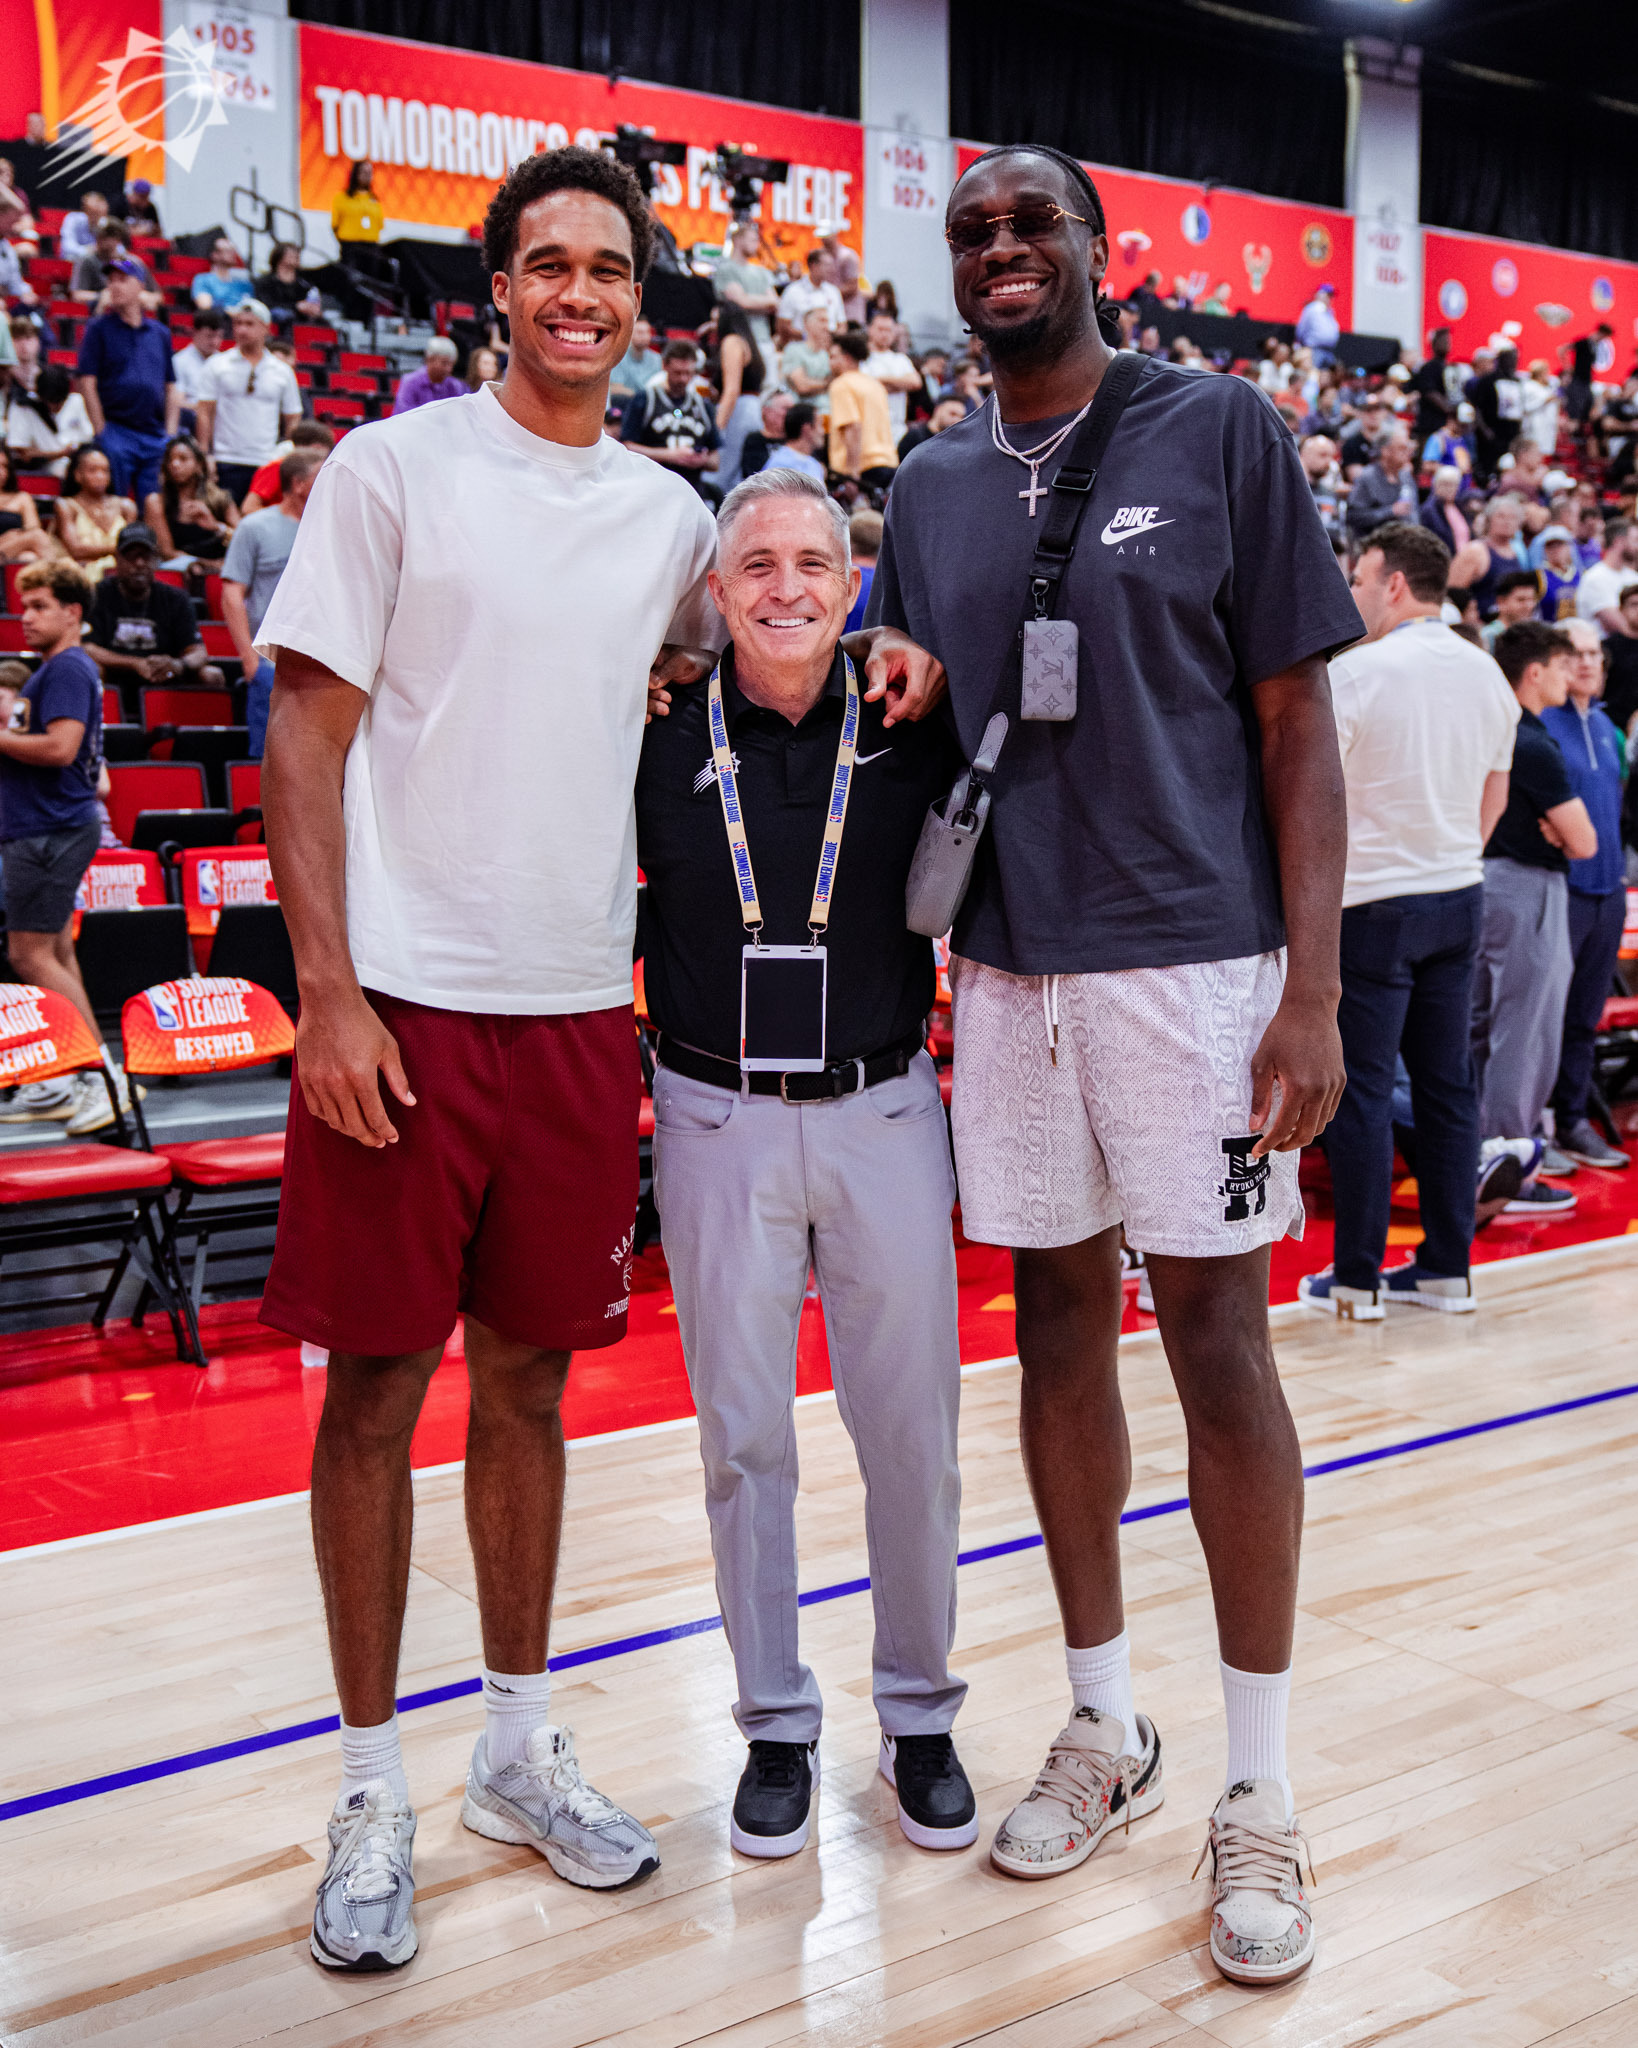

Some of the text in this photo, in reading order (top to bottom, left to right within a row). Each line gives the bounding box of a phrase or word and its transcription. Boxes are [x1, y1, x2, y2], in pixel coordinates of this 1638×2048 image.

[209, 21, 255, 55] 105
[1110, 506, 1160, 529] BIKE
[1116, 545, 1156, 556] AIR
[711, 701, 727, 749] SUMMER LEAGUE
[844, 692, 858, 741] SUMMER LEAGUE
[720, 770, 740, 824] SUMMER LEAGUE
[830, 763, 851, 817] SUMMER LEAGUE
[91, 864, 146, 885] SUMMER
[734, 847, 756, 903] SUMMER LEAGUE
[817, 840, 838, 896] SUMMER LEAGUE
[92, 885, 140, 910] LEAGUE
[175, 977, 253, 999] SUMMER
[184, 994, 250, 1028] LEAGUE
[174, 1031, 255, 1062] RESERVED
[1230, 1179, 1255, 1191] RYOKO
[1088, 1714, 1100, 1724] AIR
[348, 1791, 366, 1809] NIKE
[1242, 1786, 1253, 1796] AIR
